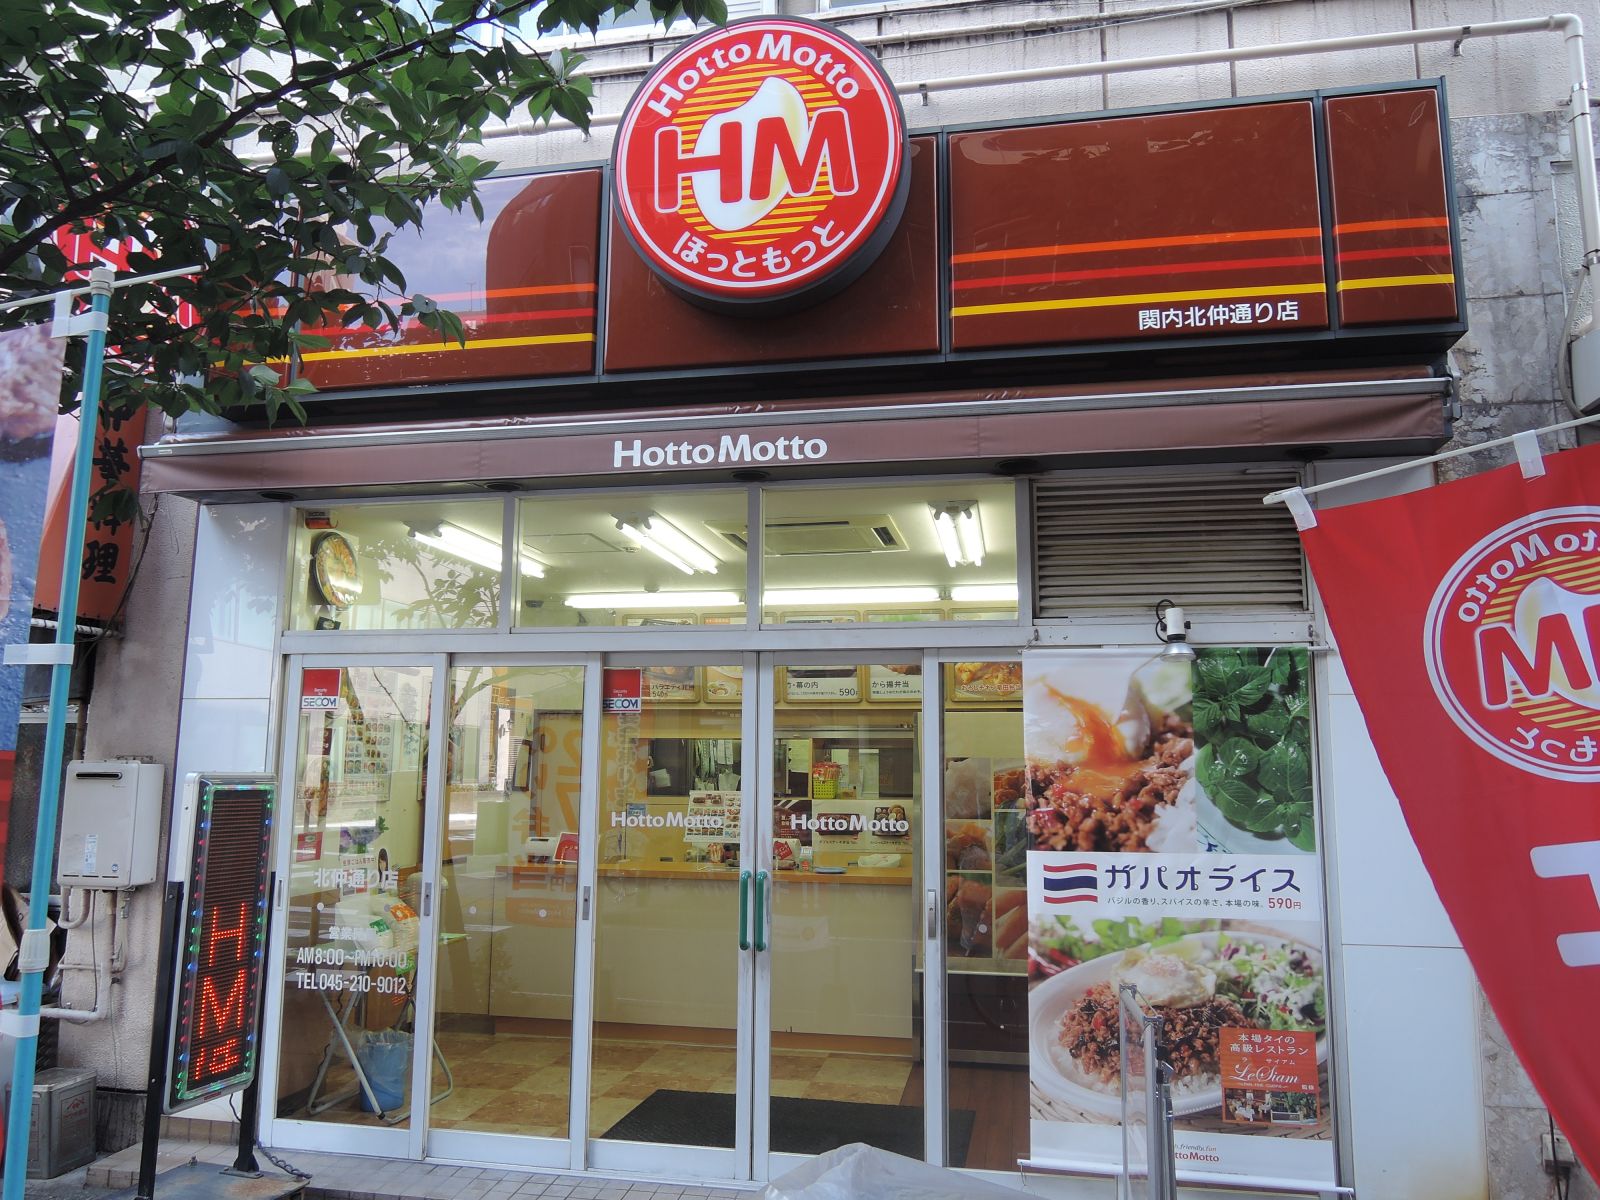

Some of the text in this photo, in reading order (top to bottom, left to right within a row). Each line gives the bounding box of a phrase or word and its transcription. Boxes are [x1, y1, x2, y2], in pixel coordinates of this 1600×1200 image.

[654, 106, 859, 214] HM
[672, 220, 845, 278] ほっともっと
[1138, 300, 1300, 331] 関内北仲通り店
[303, 697, 337, 707] SECOM
[1105, 864, 1301, 893] ガパオライス
[1268, 897, 1302, 910] 590円
[1238, 1032, 1296, 1045] 本場タイの
[1230, 1043, 1309, 1056] 高級レストラン
